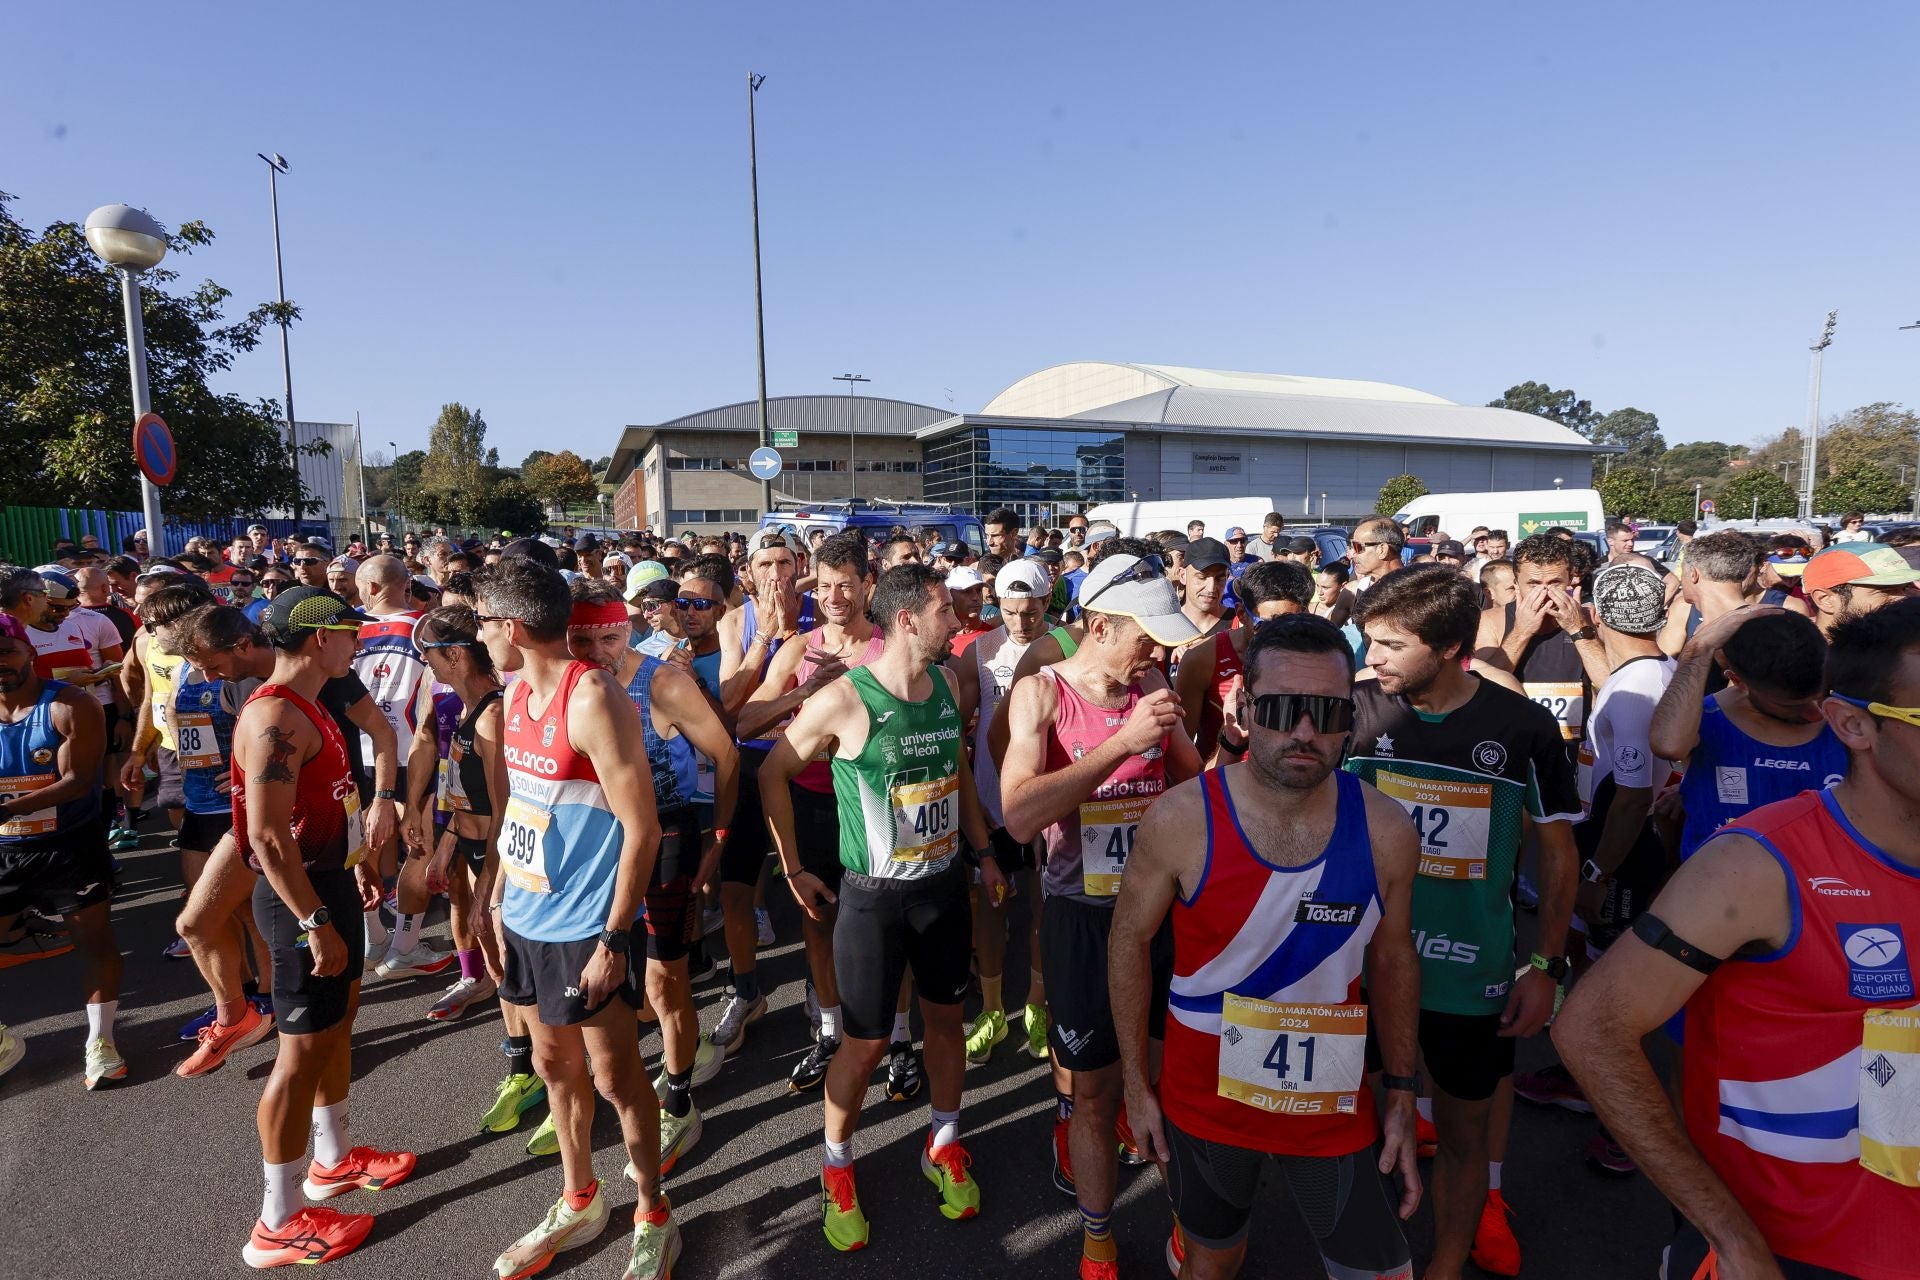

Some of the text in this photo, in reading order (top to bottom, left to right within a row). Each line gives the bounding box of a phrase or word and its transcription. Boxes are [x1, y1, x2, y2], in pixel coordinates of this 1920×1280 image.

[178, 728, 201, 751] 38
[900, 725, 959, 746] universidad
[902, 743, 940, 757] de león
[1754, 757, 1811, 771] LEGEA
[1399, 778, 1418, 788] MEDIA
[1420, 783, 1460, 793] MARATÓN
[1461, 786, 1489, 794] AVILÉS
[1415, 792, 1441, 802] 2024
[914, 798, 949, 837] 409
[1123, 811, 1142, 820] 2024
[1410, 805, 1450, 847] 42
[507, 821, 536, 865] 399
[1621, 889, 1631, 918] MIERES
[1305, 904, 1357, 922] Toscaf
[1853, 973, 1908, 983] DEPORTE
[1853, 983, 1910, 995] ASTURIANO
[1255, 1004, 1284, 1014] MEDIA
[1285, 1006, 1332, 1017] MARATÓN
[1334, 1007, 1364, 1018] AVILÉS
[1279, 1018, 1310, 1029] 2024
[1262, 1034, 1316, 1082] 41
[1281, 1081, 1298, 1091] ISRA
[1251, 1092, 1324, 1113] avilés
